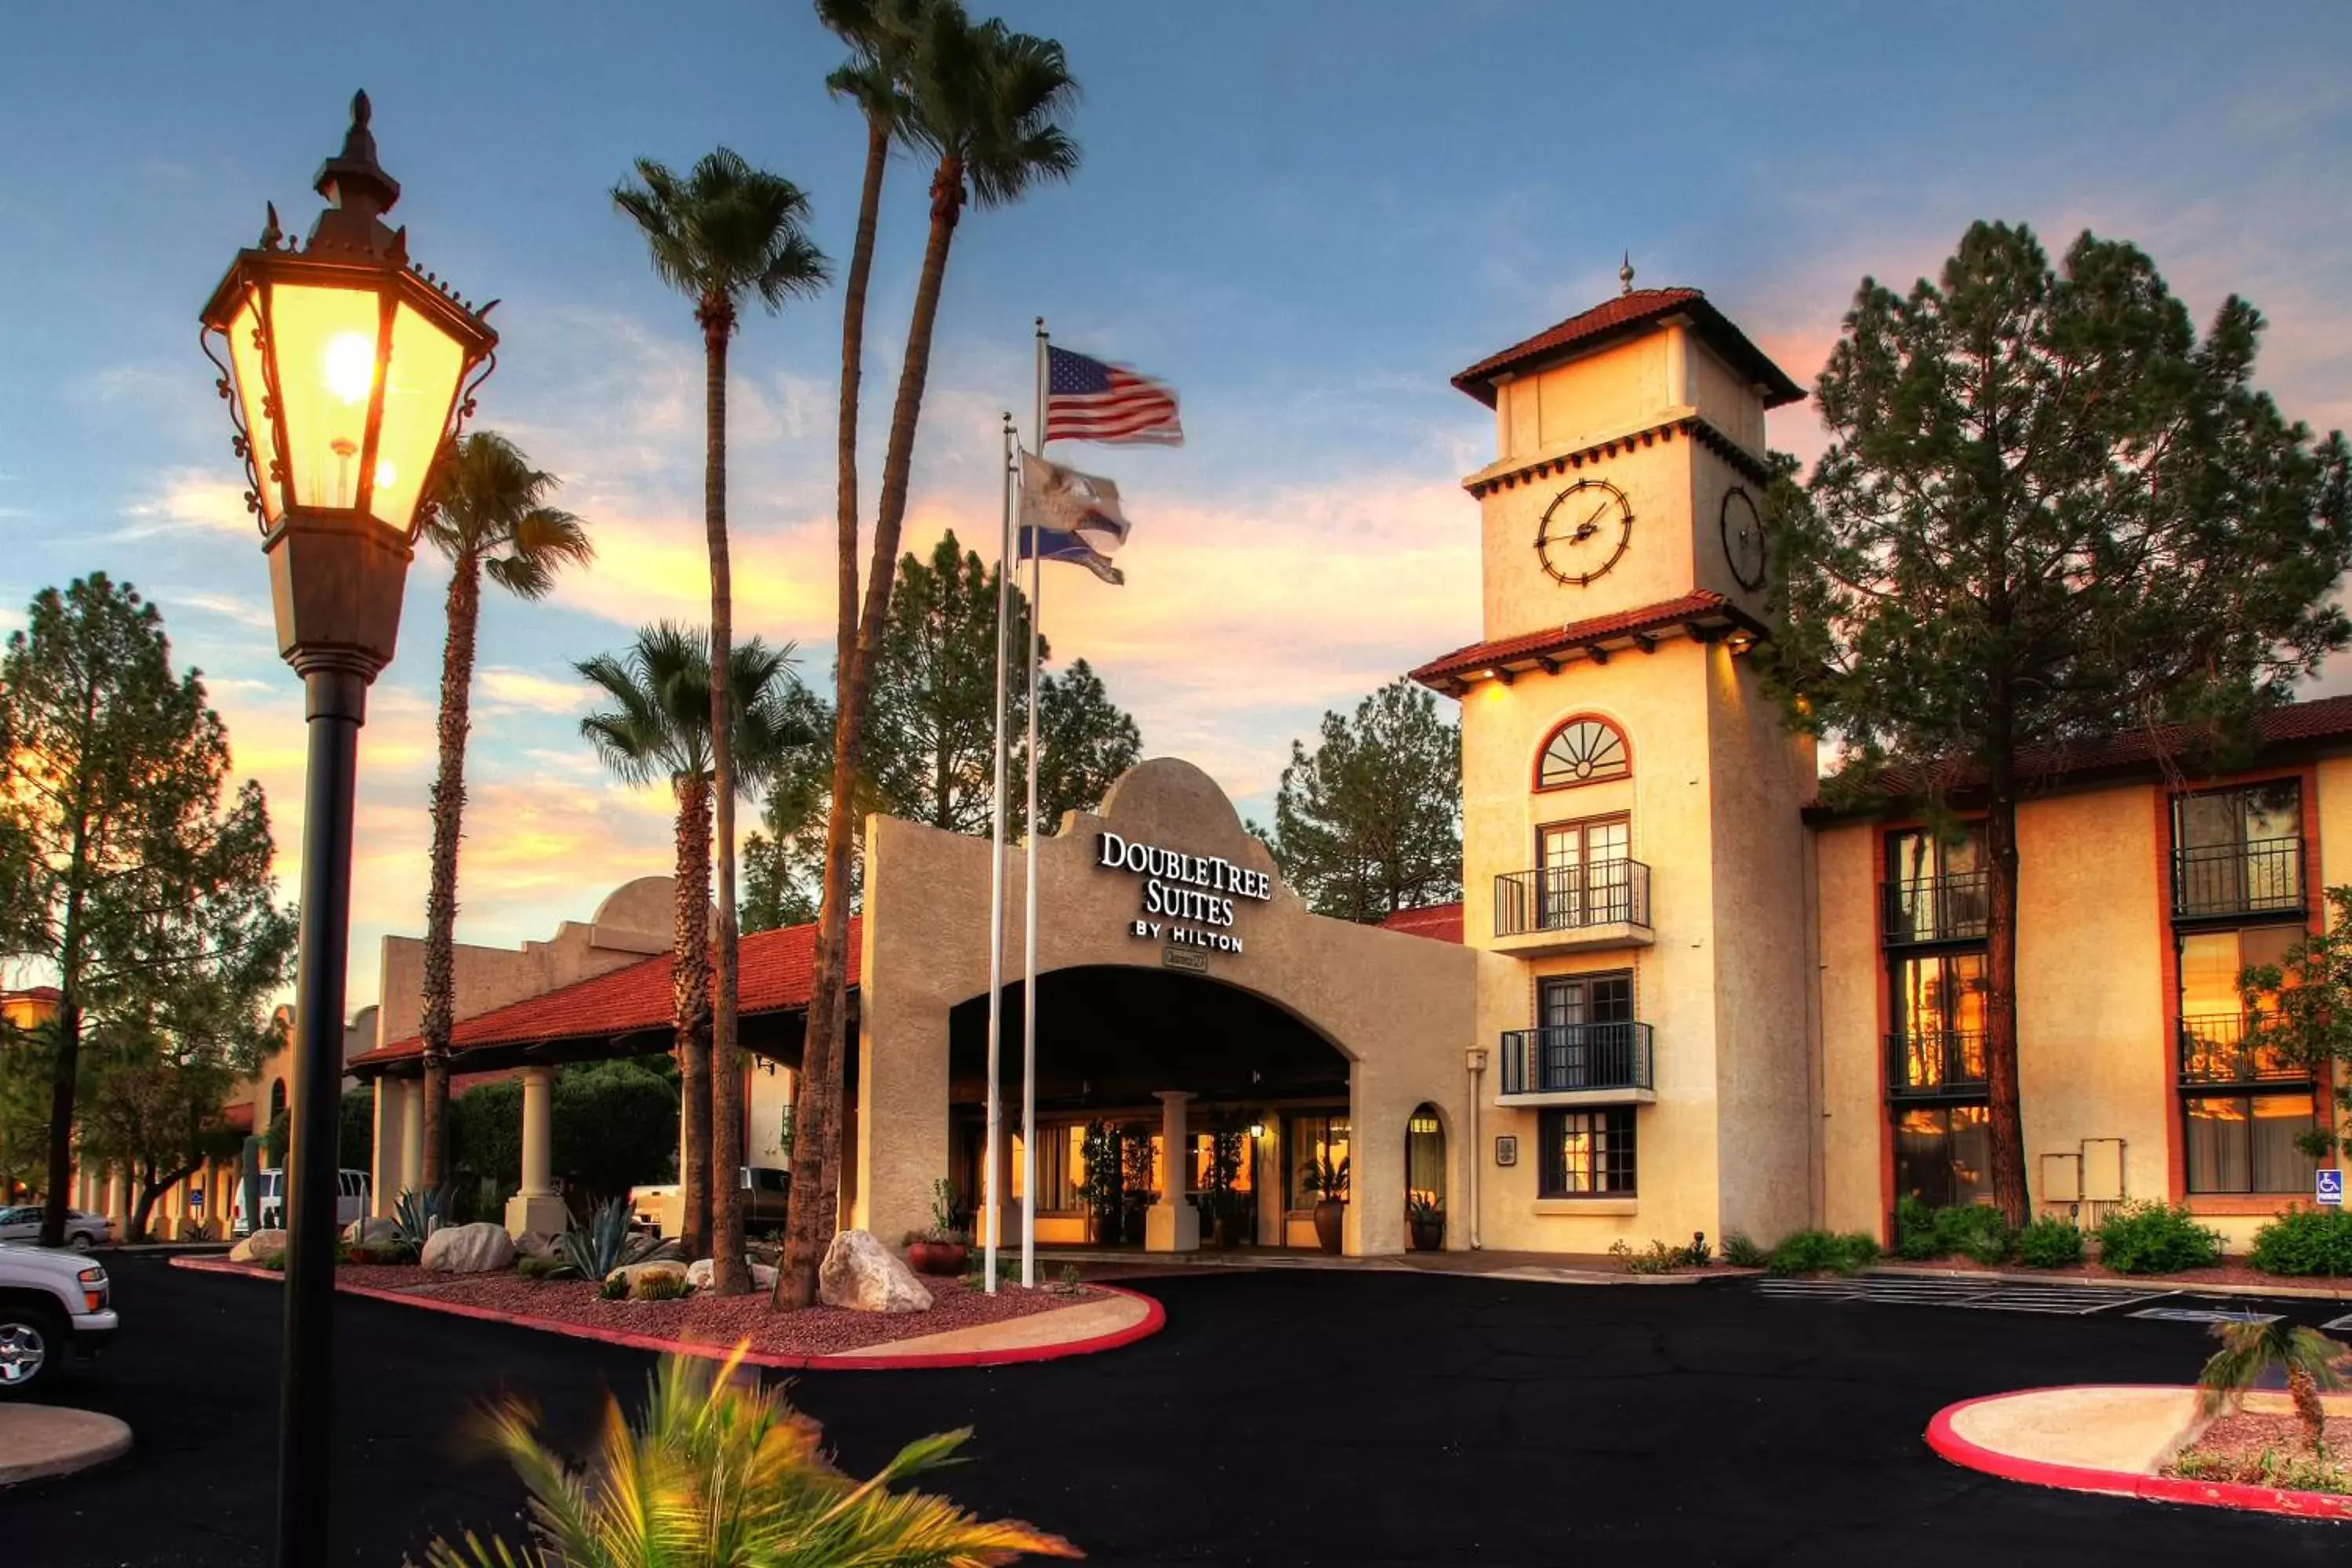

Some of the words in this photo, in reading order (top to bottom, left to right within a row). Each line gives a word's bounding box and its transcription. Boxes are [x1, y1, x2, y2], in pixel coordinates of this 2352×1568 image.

[1147, 879, 1233, 927] SUITES
[1136, 920, 1161, 938] BY
[1174, 926, 1243, 953] HILTON
